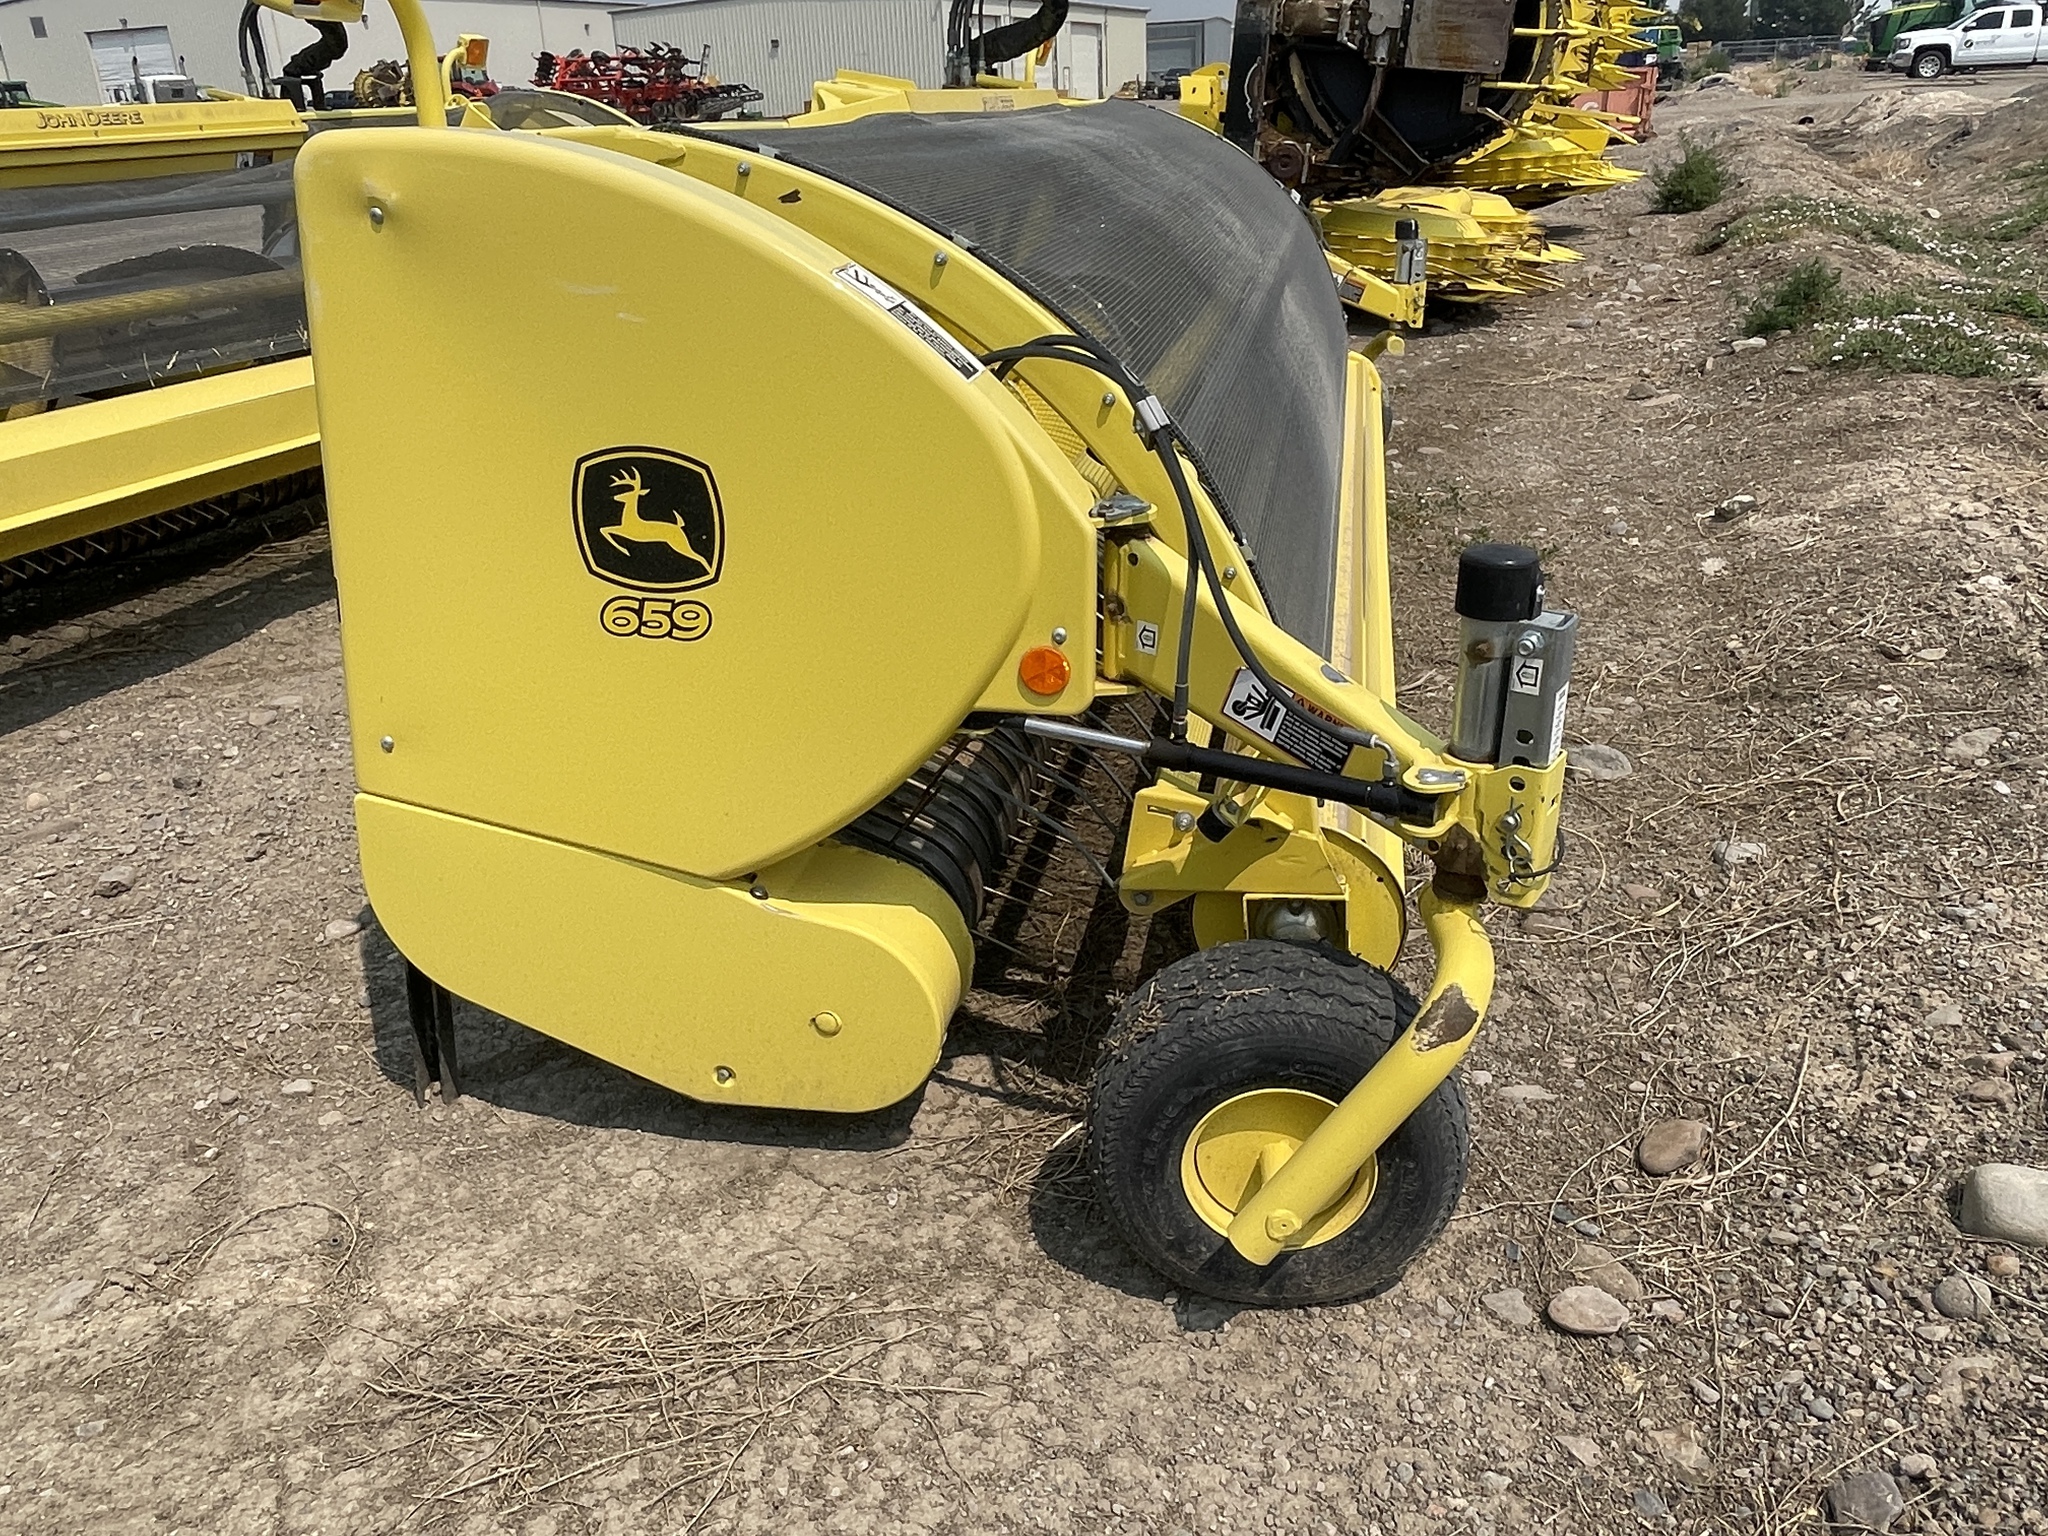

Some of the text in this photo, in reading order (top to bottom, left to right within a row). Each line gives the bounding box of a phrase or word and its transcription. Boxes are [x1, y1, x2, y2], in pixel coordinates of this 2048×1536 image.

[36, 109, 144, 129] JOHN DEERE
[600, 595, 713, 642] 659
